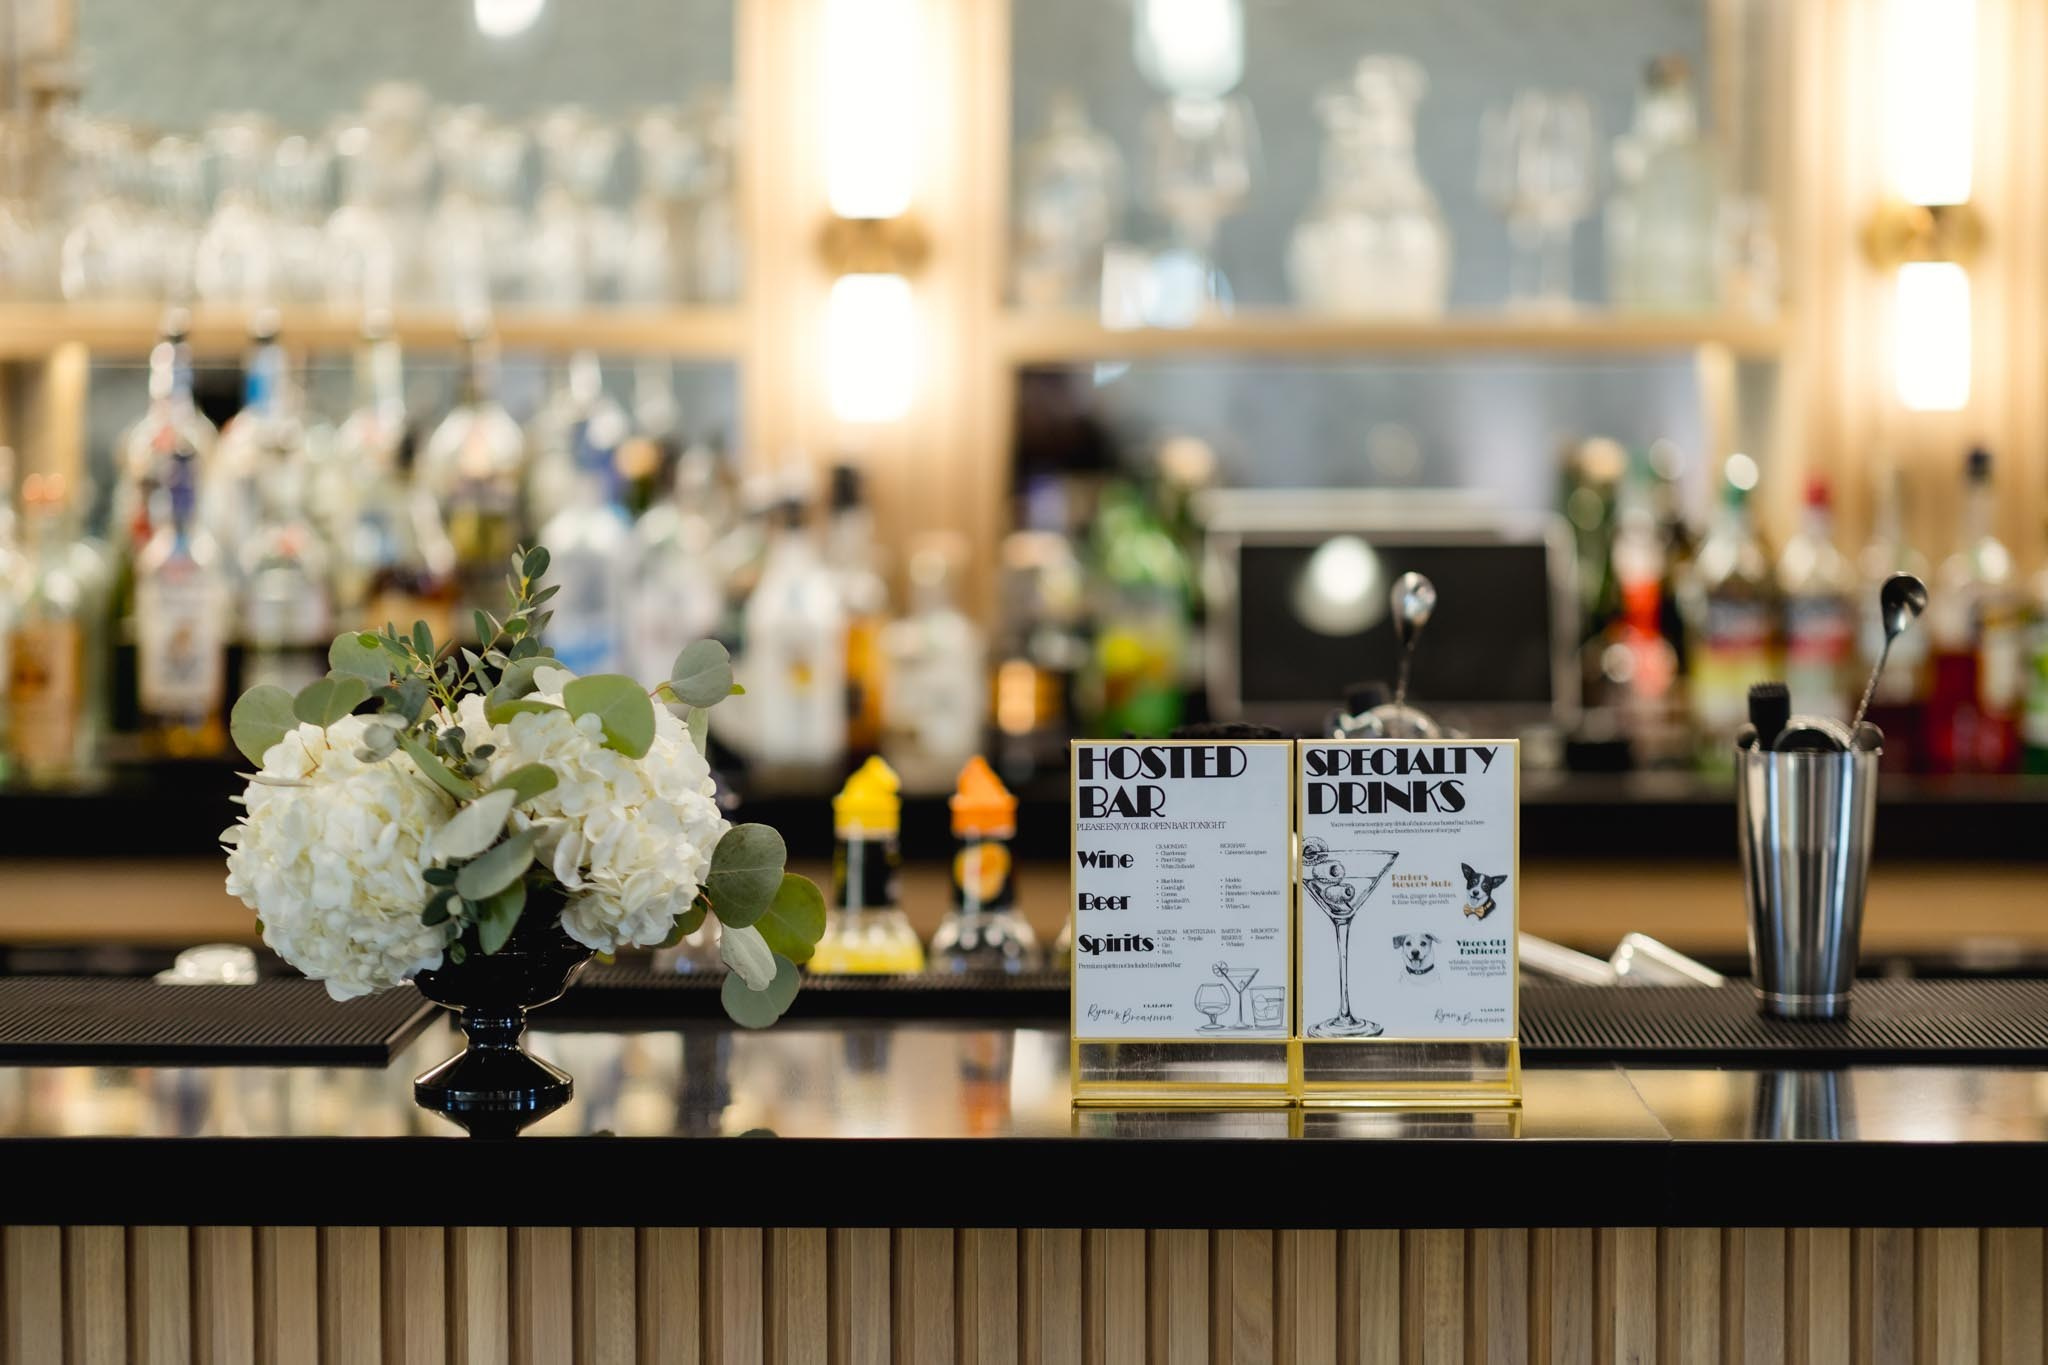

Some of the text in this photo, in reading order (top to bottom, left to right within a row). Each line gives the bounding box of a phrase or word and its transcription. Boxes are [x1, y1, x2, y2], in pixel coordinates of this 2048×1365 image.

[1079, 746, 1247, 780] HOSTED
[1306, 747, 1498, 776] SPECIALTY
[1079, 785, 1166, 818] BAR
[1308, 780, 1465, 814] DRINKS
[1076, 822, 1105, 831] PLEASE
[1106, 822, 1130, 831] ENJOY
[1150, 821, 1171, 830] OPEN
[1172, 821, 1188, 830] BAR
[1188, 820, 1227, 830] TONIGHT
[1077, 850, 1134, 868] Wine
[1079, 892, 1131, 910] Beer
[1078, 934, 1154, 955] Spirits
